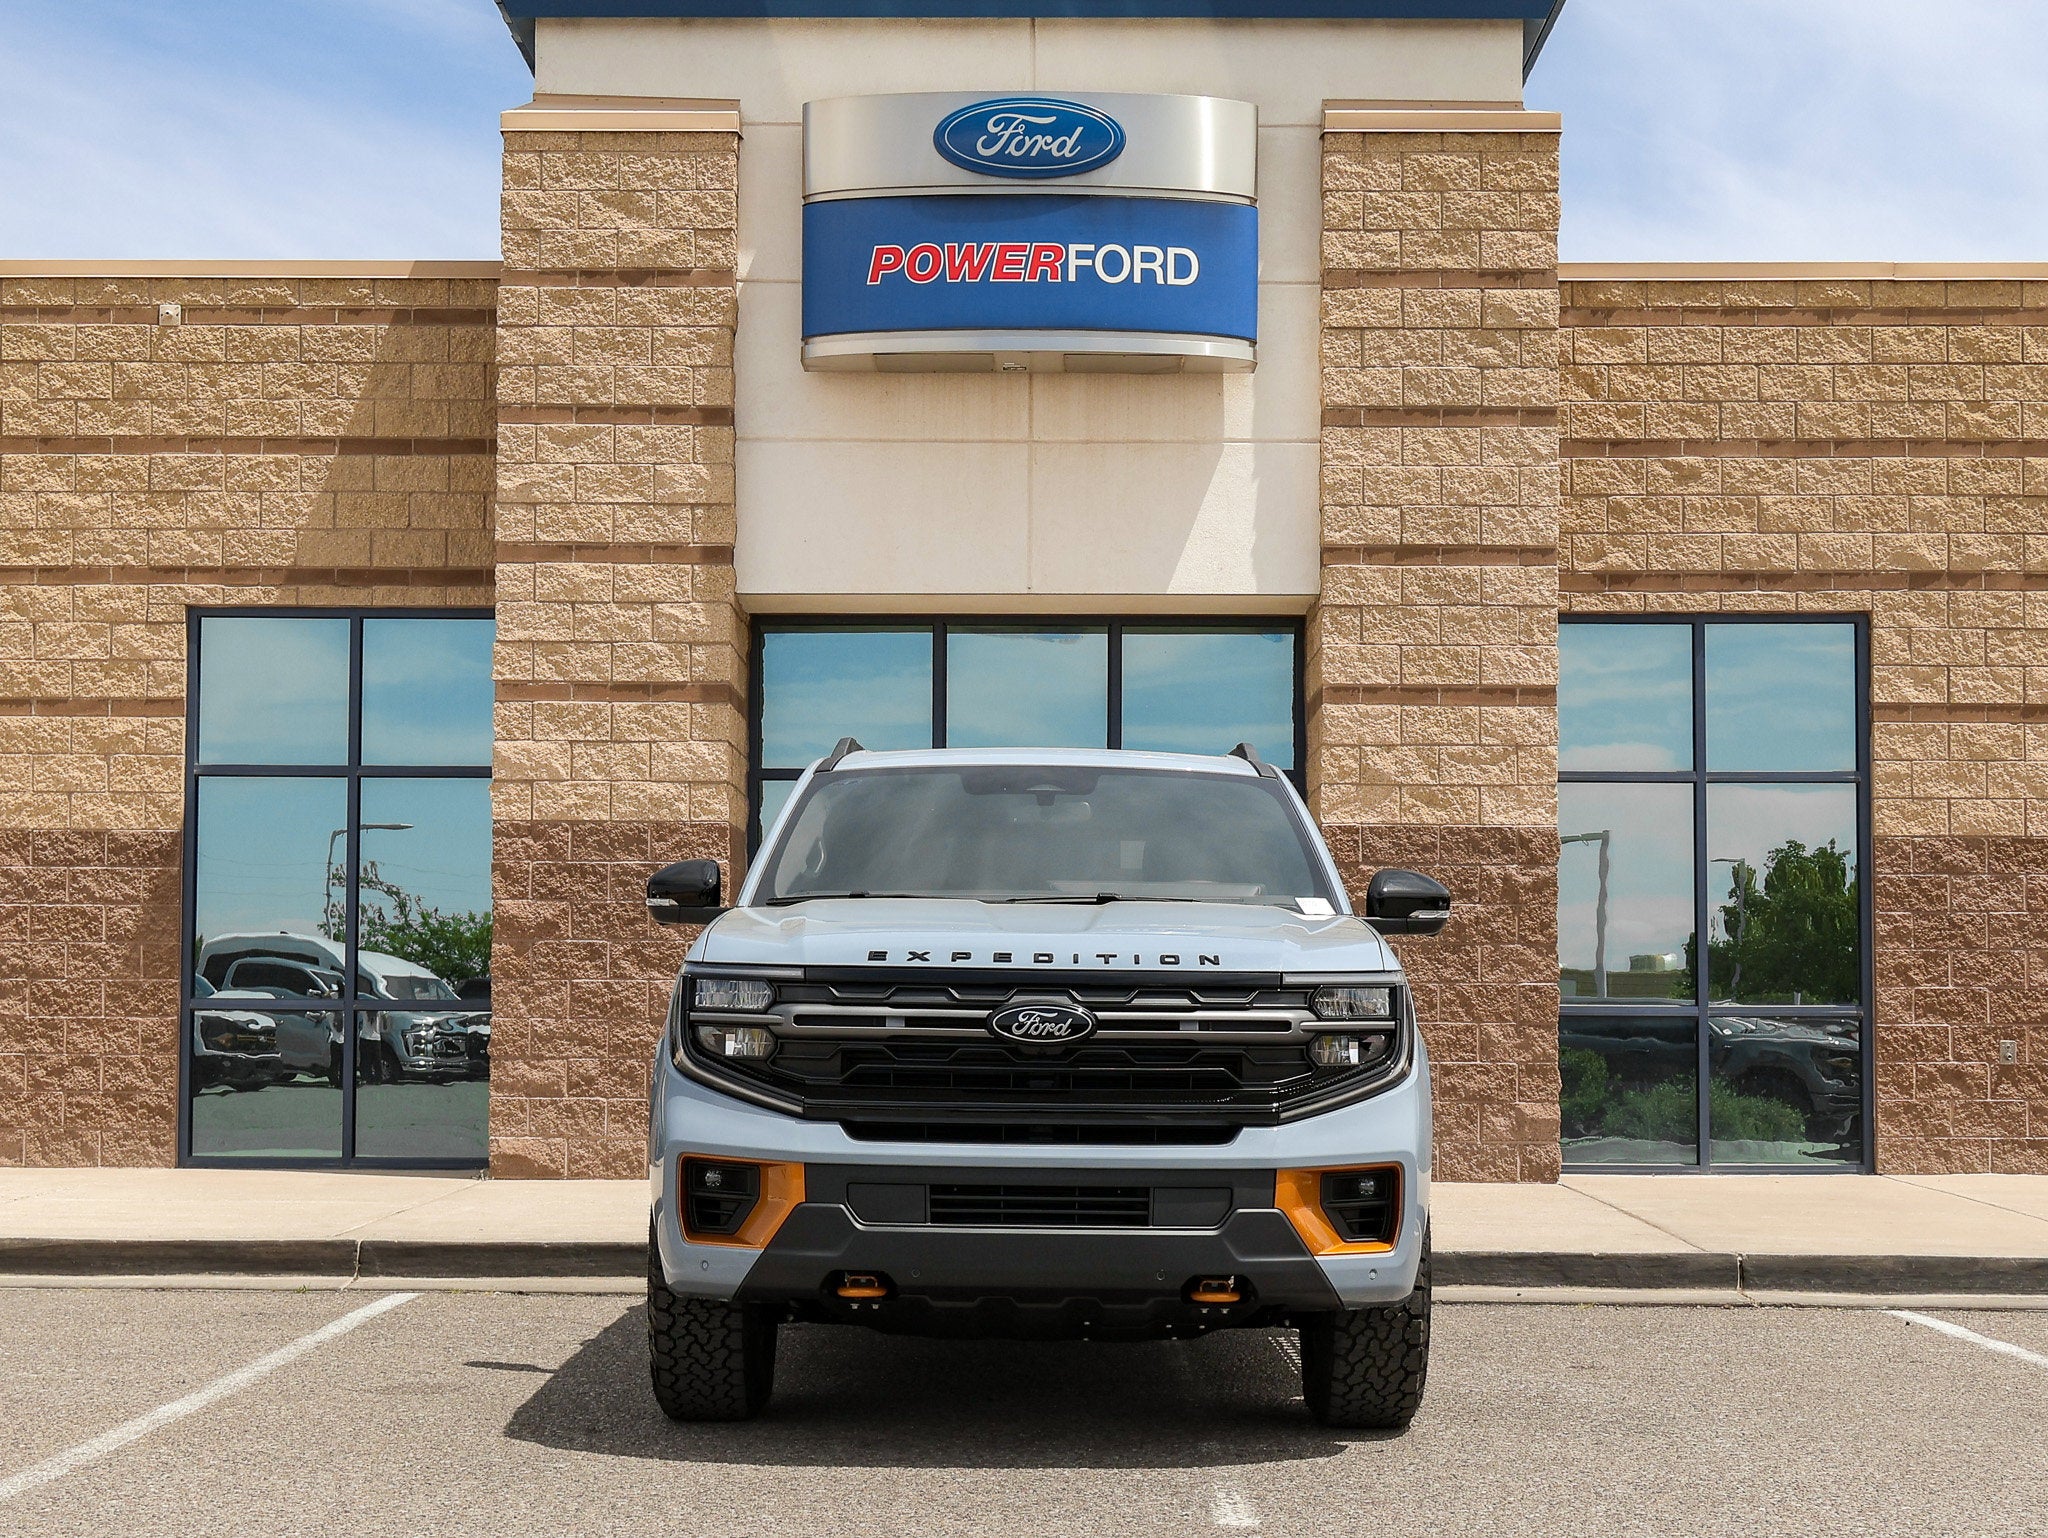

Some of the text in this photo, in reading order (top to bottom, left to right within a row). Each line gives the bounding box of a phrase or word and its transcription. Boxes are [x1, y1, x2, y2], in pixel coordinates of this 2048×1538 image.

[976, 113, 1084, 158] Ford
[867, 950, 1221, 967] EXPEDITION
[1011, 1010, 1073, 1036] Ford
